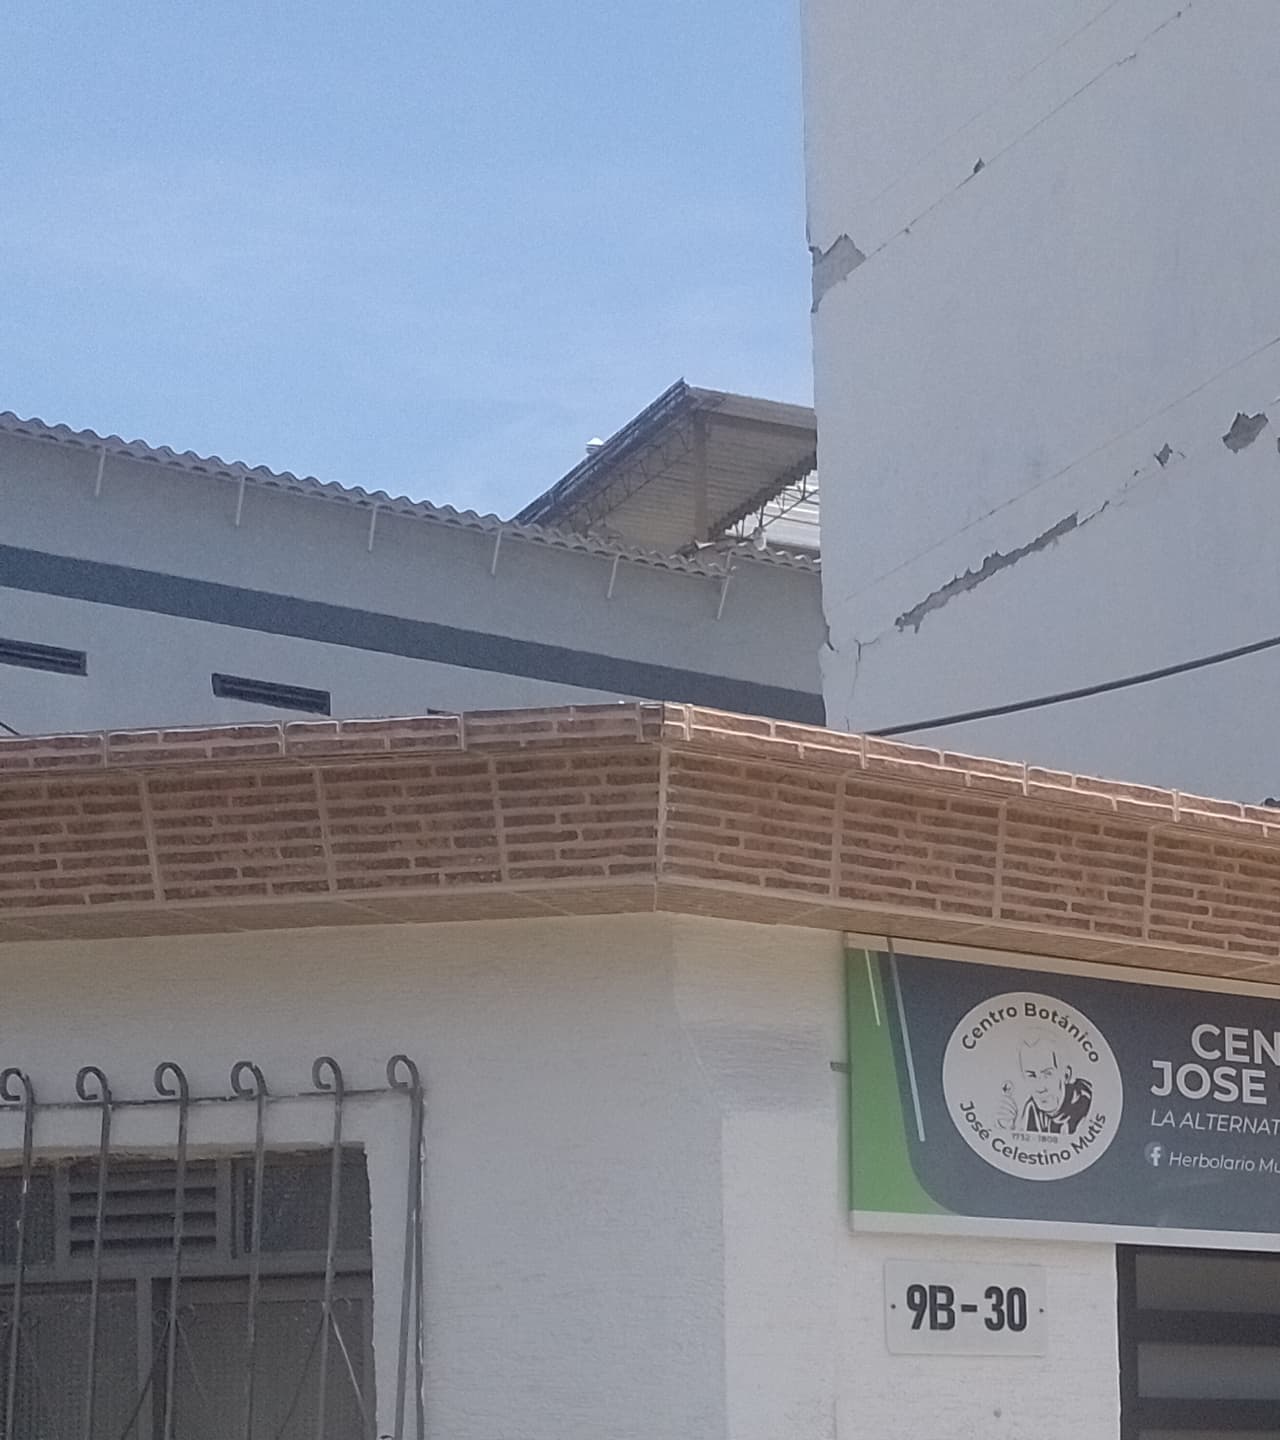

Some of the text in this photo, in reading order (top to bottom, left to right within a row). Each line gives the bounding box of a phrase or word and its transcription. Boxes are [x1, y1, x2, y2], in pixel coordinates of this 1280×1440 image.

[962, 1002, 1099, 1063] Centro Botánico
[1150, 1059, 1267, 1105] JOSE
[960, 1101, 1106, 1166] José Celestino Mutis
[1151, 1109, 1175, 1127] LA
[1168, 1151, 1255, 1171] Herbolario
[906, 1284, 1028, 1332] 9B-30
